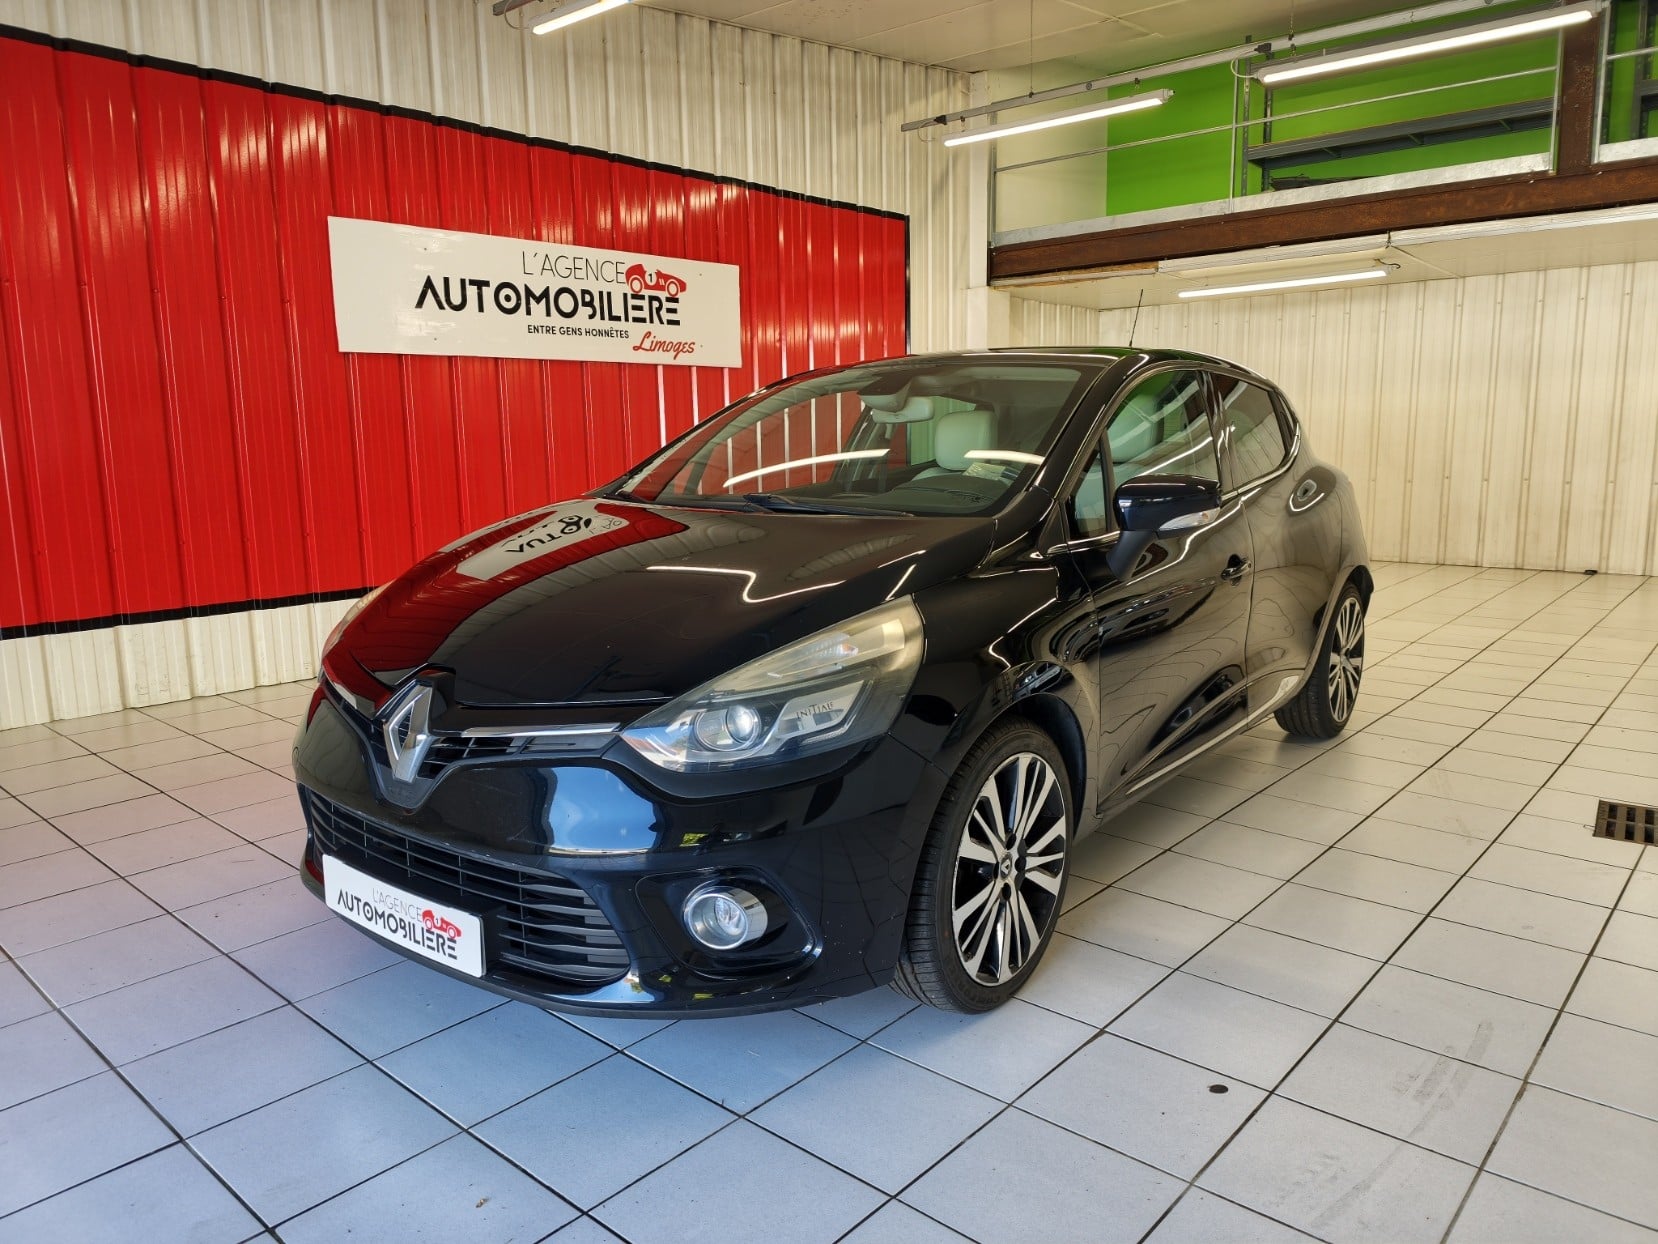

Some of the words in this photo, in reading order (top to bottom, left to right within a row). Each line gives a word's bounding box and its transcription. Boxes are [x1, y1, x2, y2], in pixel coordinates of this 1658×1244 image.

[522, 250, 626, 284] L'AGENCE
[527, 324, 557, 335] ENTRE
[559, 325, 583, 336] GENS
[585, 326, 630, 339] HONNÊTES
[632, 330, 696, 360] Limoges
[372, 887, 423, 923] L'AGENCE
